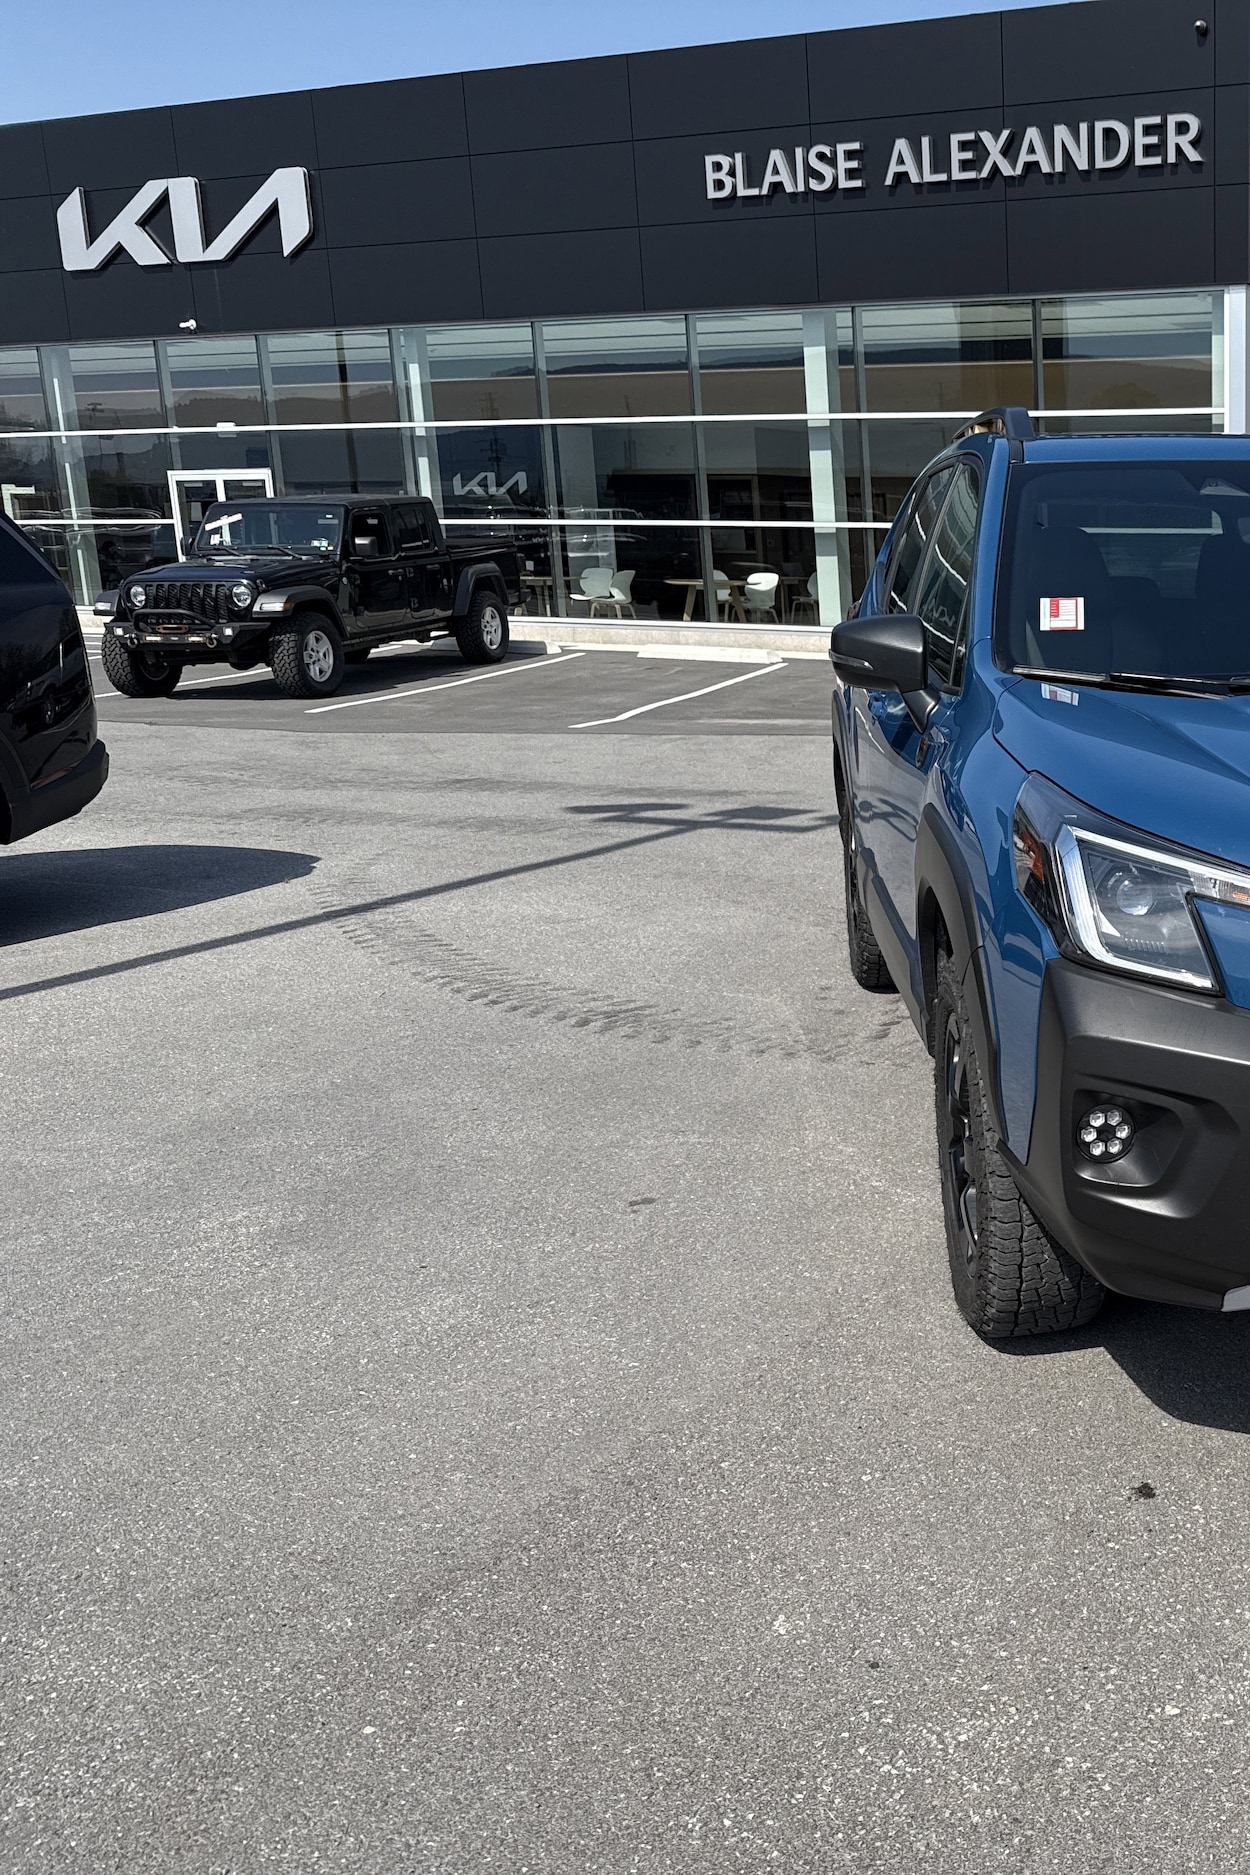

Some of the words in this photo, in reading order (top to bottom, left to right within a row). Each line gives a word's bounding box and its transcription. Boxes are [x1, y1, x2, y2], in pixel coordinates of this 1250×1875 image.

[704, 142, 864, 200] BLAISE
[884, 113, 1204, 187] ALEXANDER
[57, 166, 313, 272] KIA
[452, 471, 528, 496] KIA
